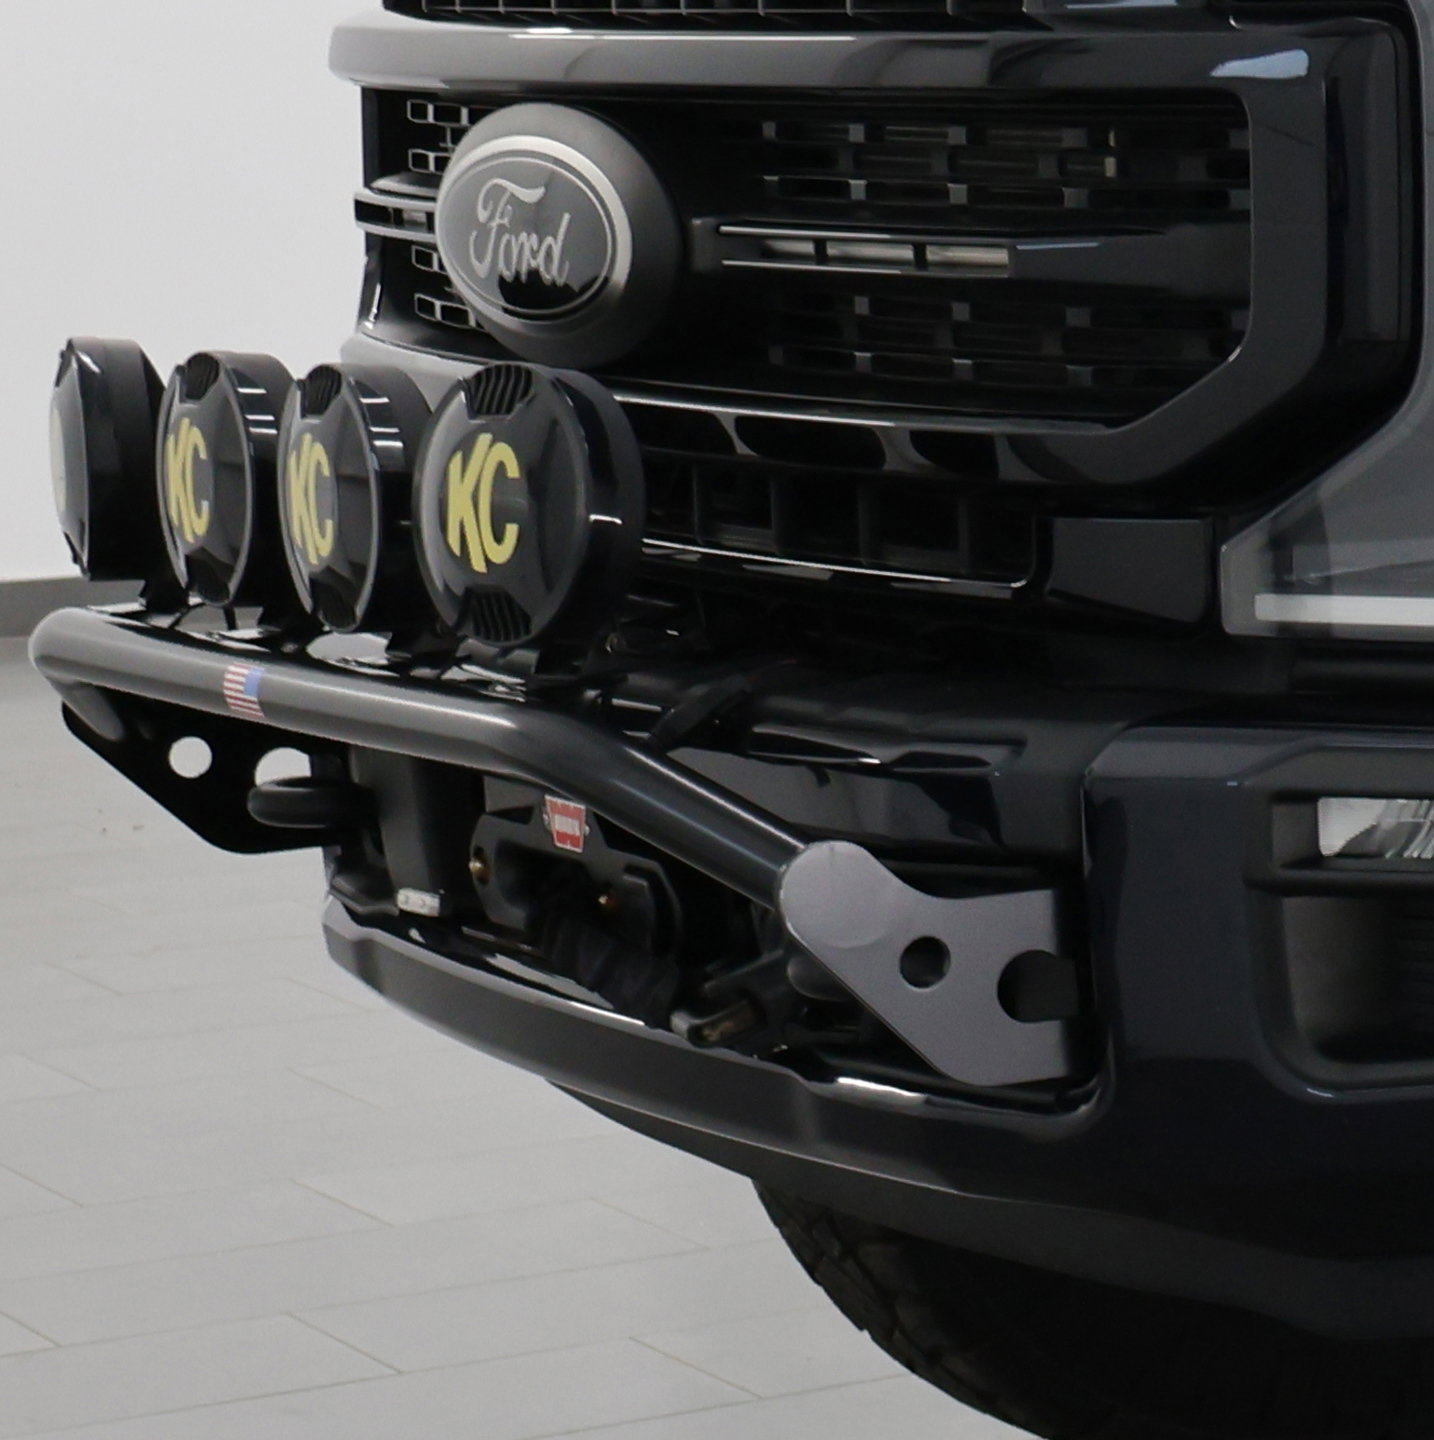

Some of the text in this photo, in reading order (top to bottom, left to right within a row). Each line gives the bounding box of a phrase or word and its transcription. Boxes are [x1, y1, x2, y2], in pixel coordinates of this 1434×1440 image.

[469, 177, 571, 288] Ford
[164, 416, 210, 544] KC
[288, 432, 333, 566] KC
[446, 432, 520, 574] KC
